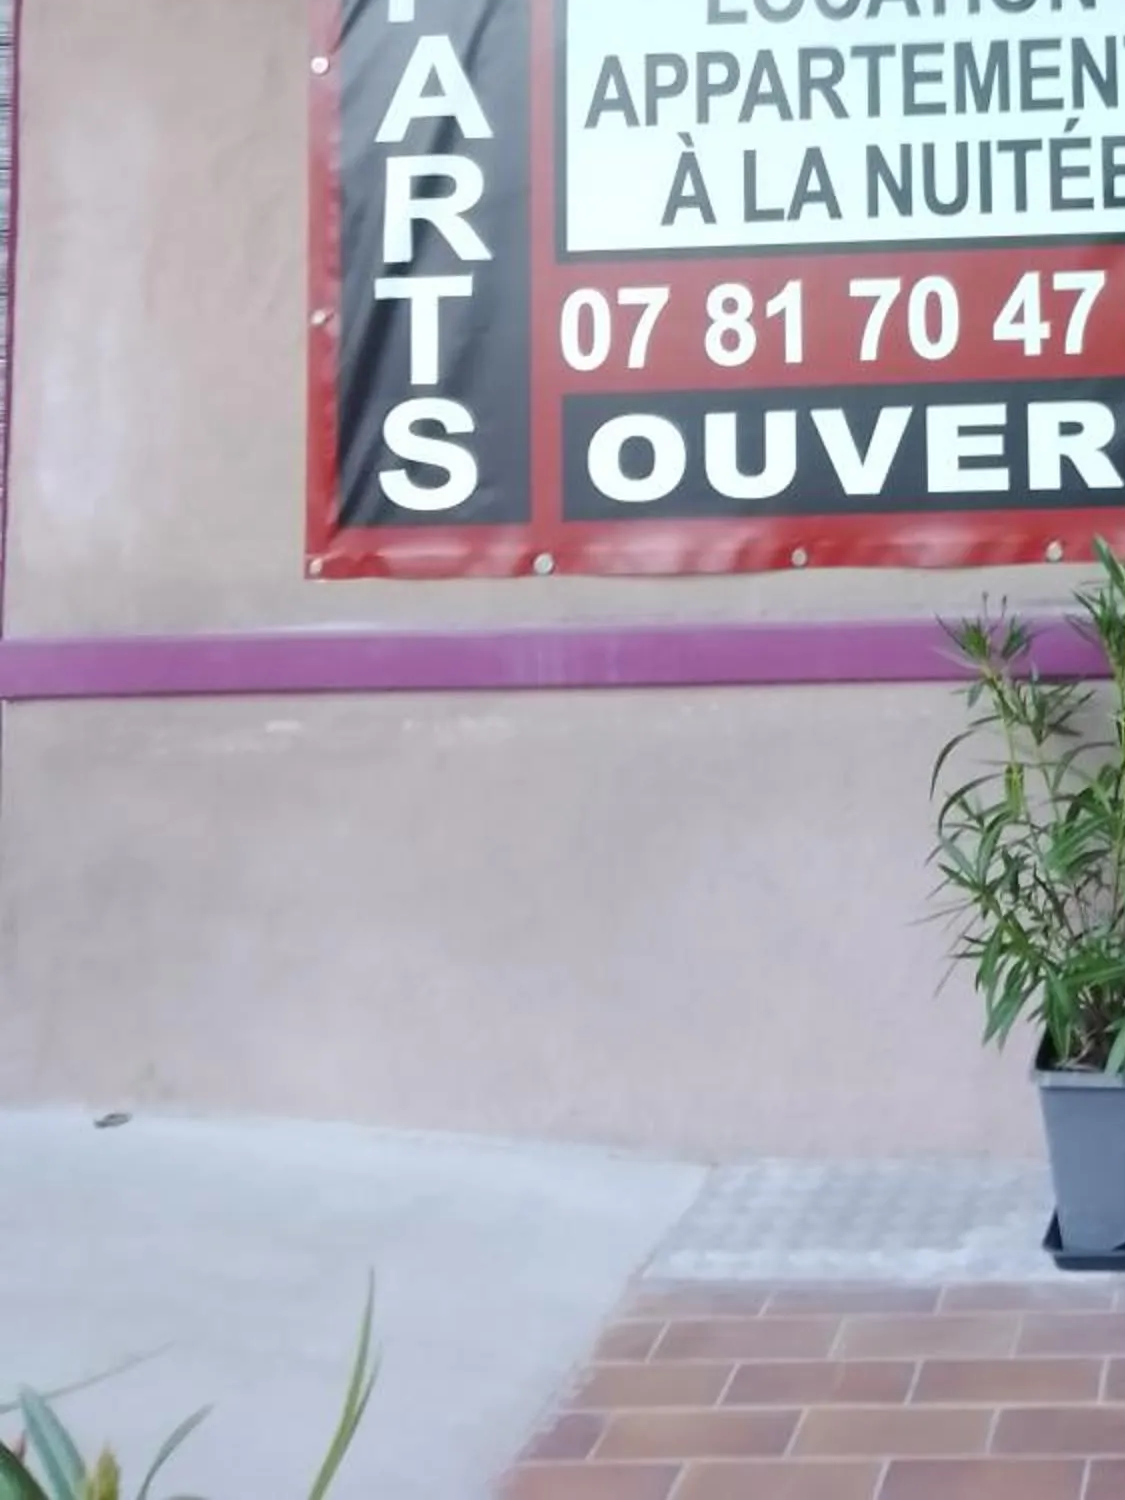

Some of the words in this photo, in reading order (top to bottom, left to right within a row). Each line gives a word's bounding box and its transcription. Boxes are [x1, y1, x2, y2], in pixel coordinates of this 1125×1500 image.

[661, 132, 717, 226] À
[743, 146, 842, 223] LA
[560, 286, 670, 371] 07
[704, 280, 802, 367] 81
[849, 275, 960, 361] 70
[993, 271, 1107, 356] 47
